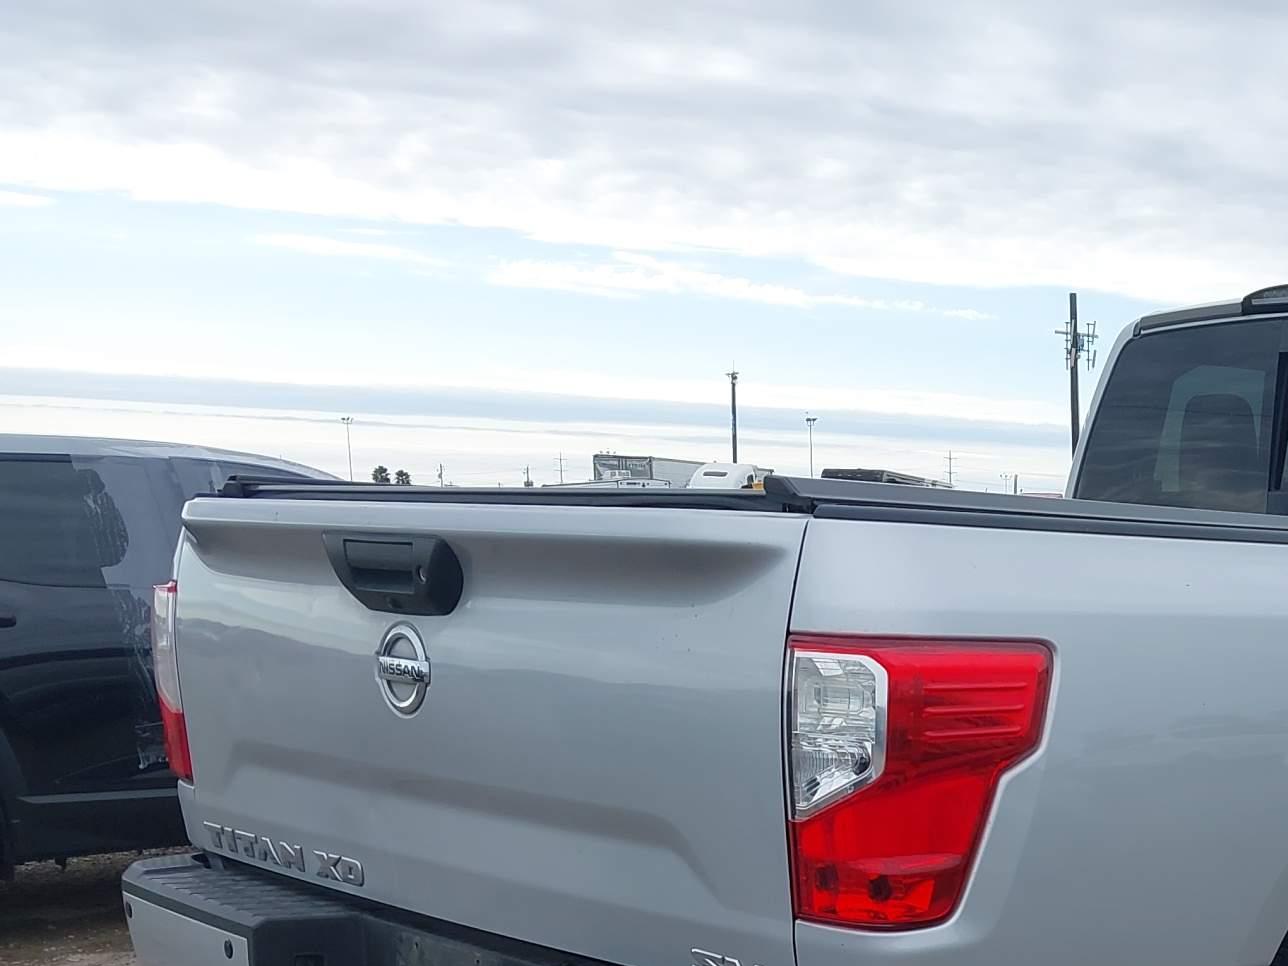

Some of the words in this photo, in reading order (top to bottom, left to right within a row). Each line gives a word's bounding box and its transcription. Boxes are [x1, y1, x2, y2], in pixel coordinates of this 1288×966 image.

[379, 661, 421, 678] NISSAN
[203, 820, 306, 873] TITAN
[312, 849, 366, 888] XD
